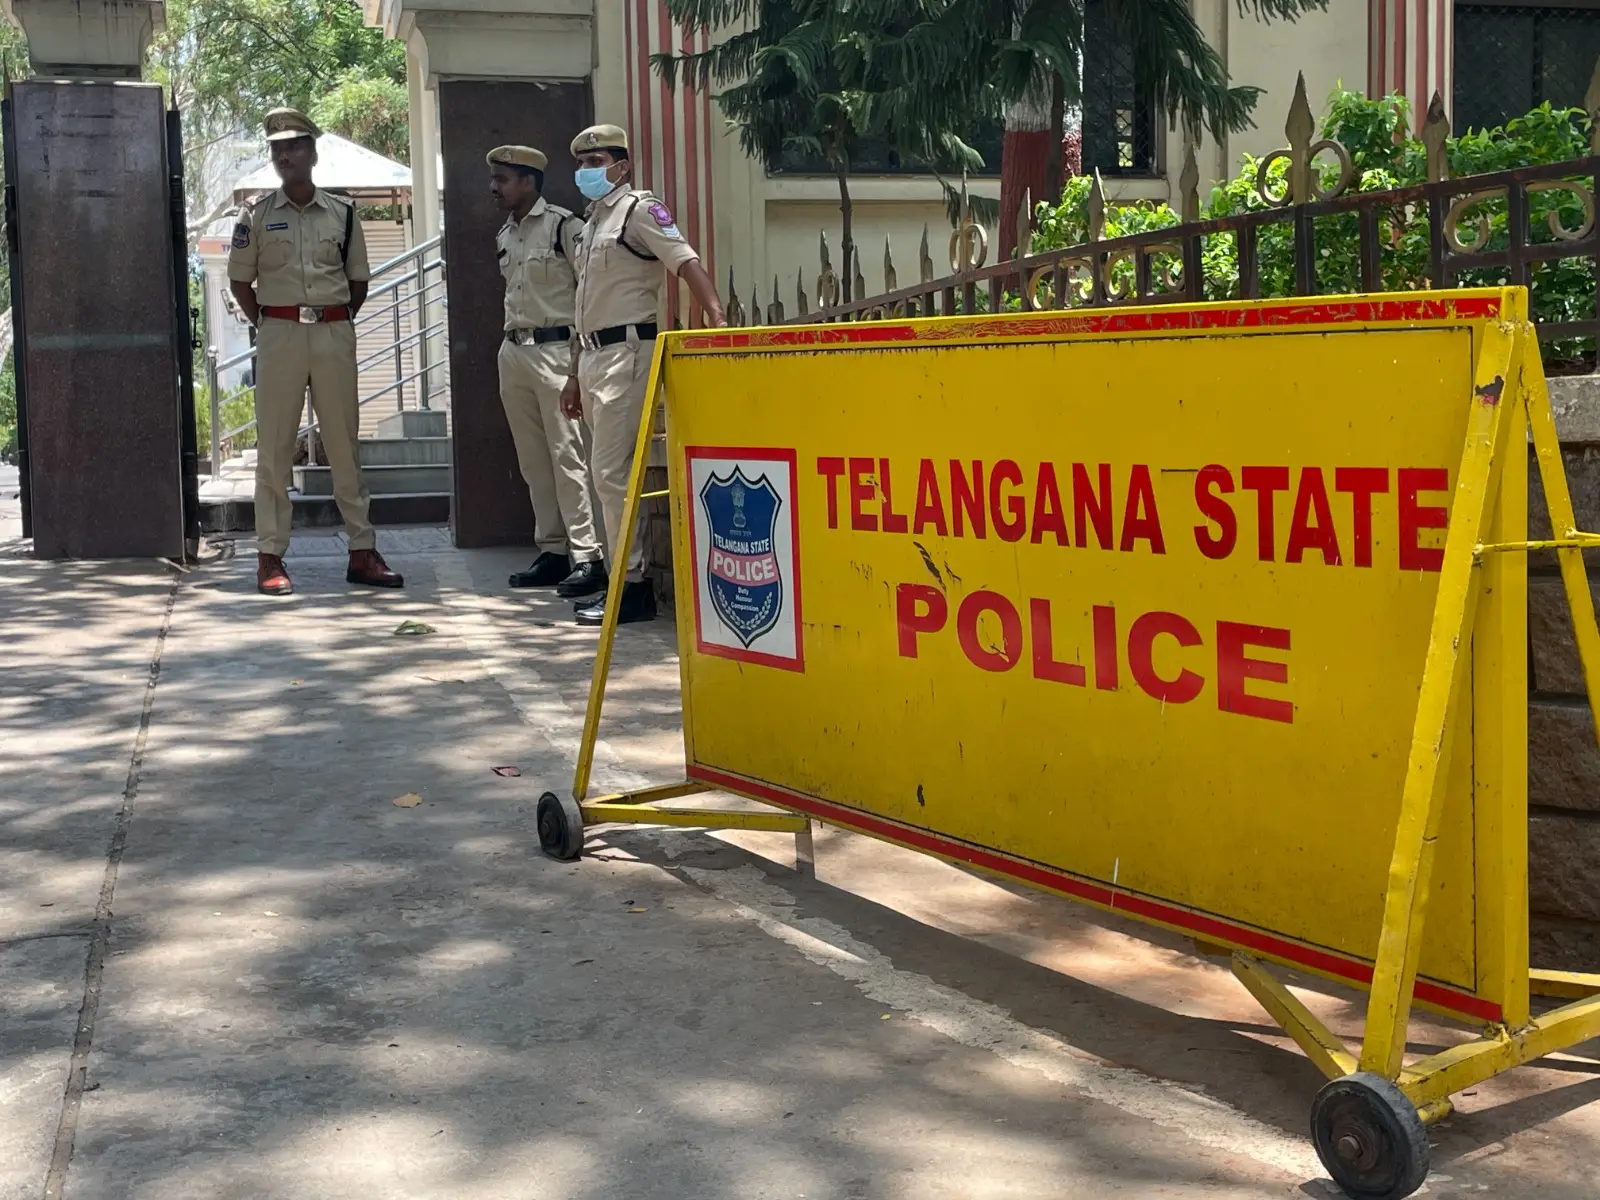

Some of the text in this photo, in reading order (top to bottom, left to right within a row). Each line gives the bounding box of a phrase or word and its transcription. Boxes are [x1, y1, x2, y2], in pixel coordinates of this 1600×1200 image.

[714, 533, 750, 554] TELANGANA
[750, 538, 770, 554] STATE
[817, 457, 1449, 573] TELANGANA STATE
[713, 551, 774, 581] POLICE
[896, 583, 1293, 724] POLICE
